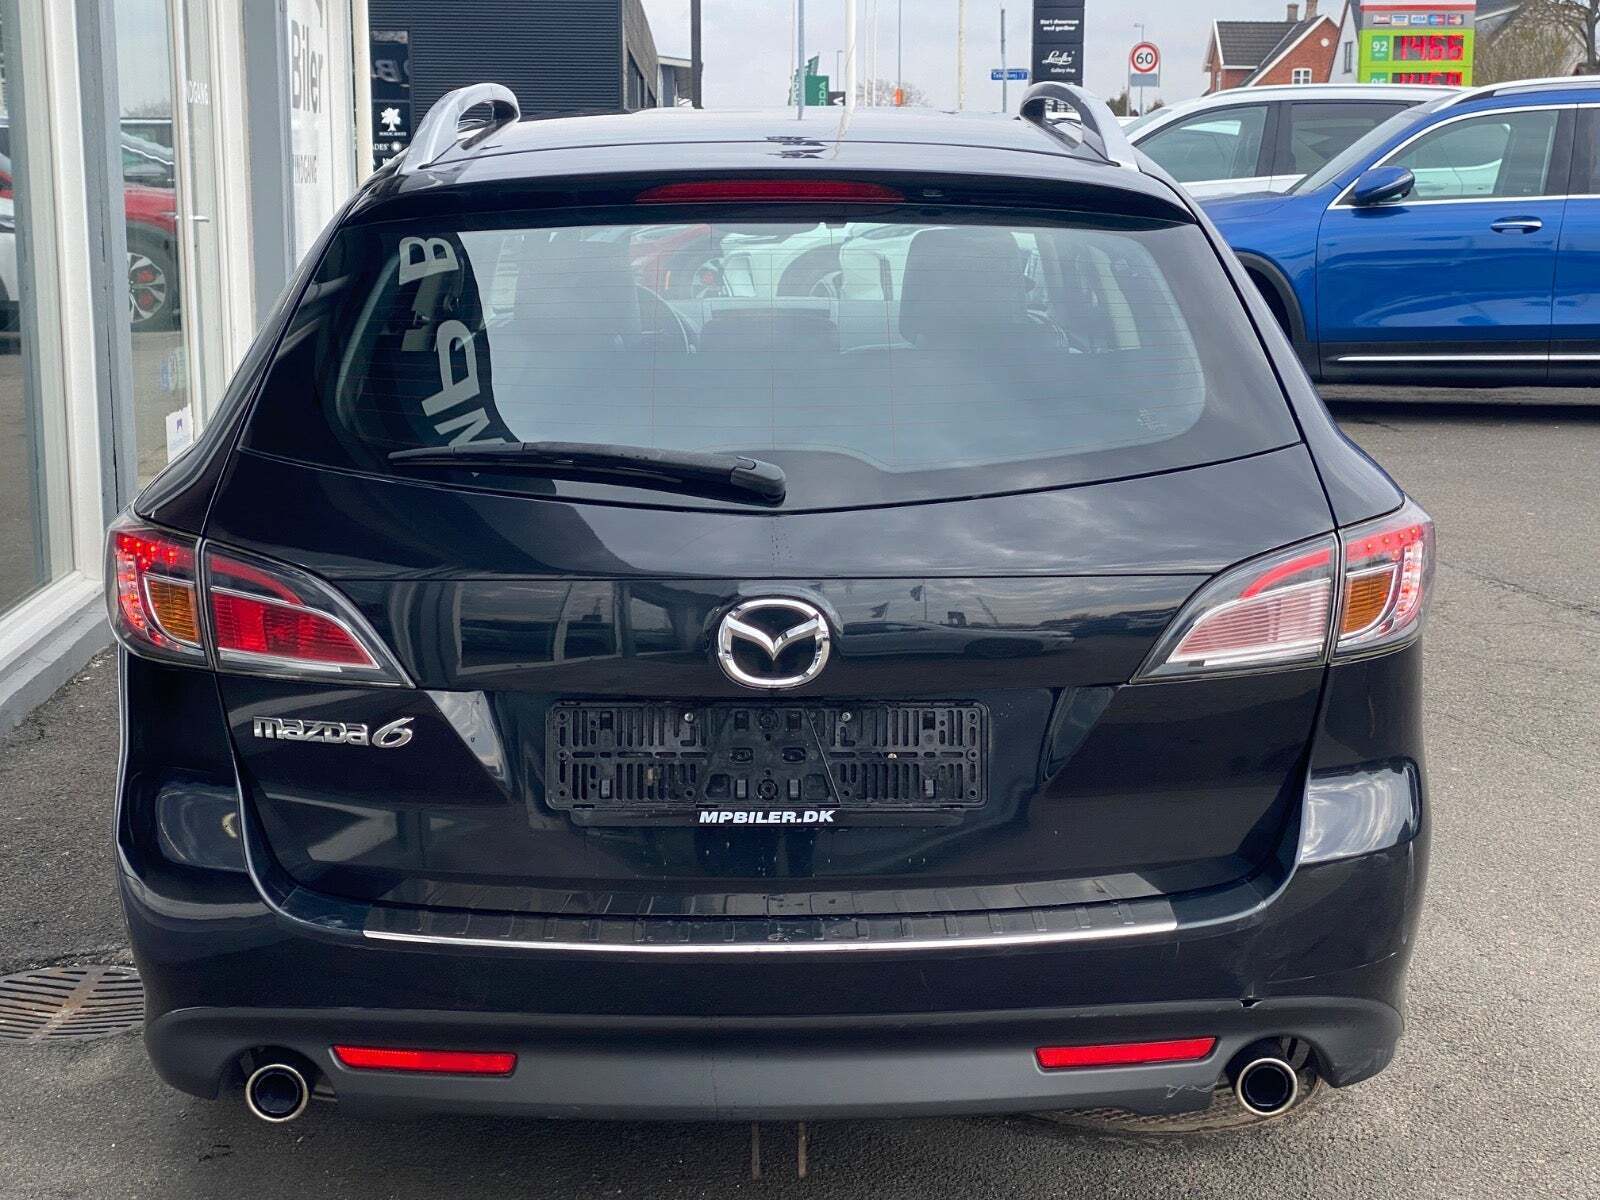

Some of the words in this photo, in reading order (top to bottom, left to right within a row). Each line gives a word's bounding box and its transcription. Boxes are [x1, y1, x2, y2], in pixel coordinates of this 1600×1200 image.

[1372, 41, 1388, 52] 92
[1136, 52, 1153, 64] 60
[291, 19, 323, 114] Biler
[698, 809, 836, 825] MPBILER.DK
